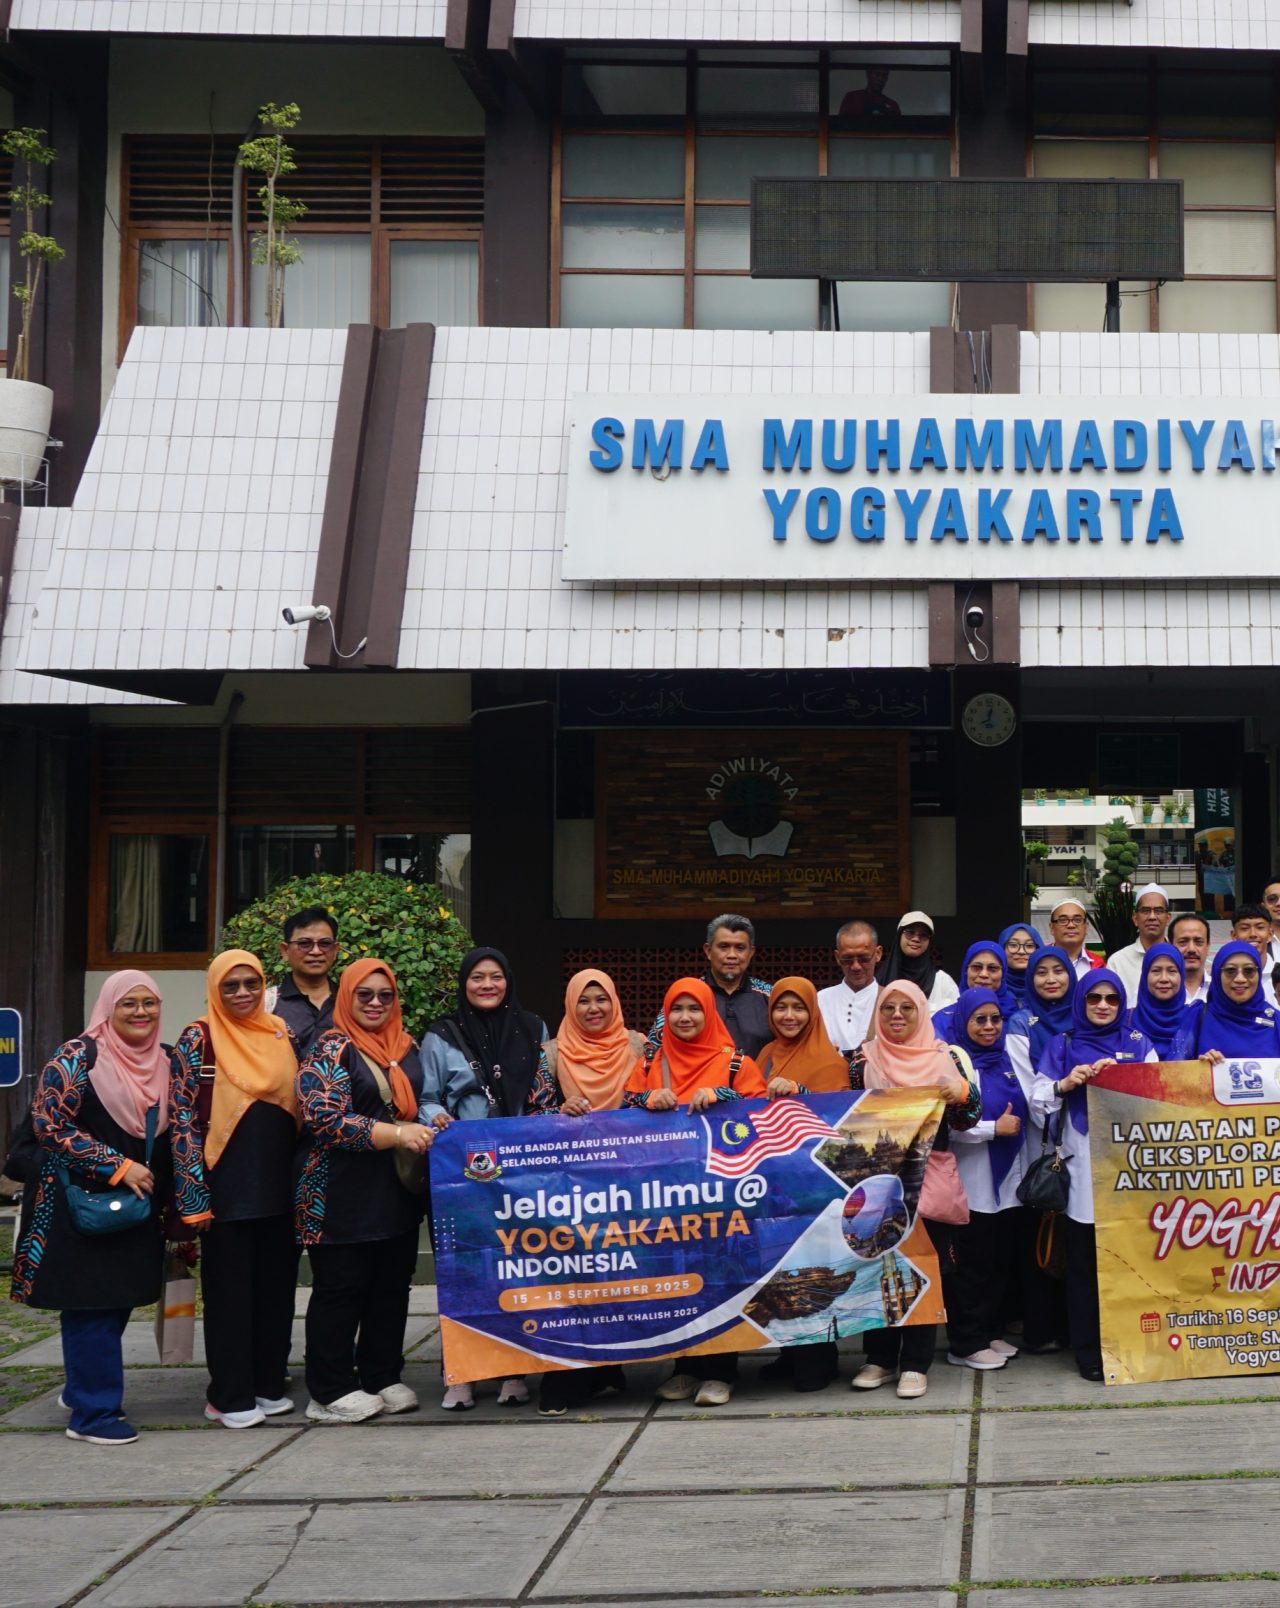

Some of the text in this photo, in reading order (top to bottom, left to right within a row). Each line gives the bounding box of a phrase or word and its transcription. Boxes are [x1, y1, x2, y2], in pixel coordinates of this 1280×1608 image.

[589, 416, 730, 474] SMA
[763, 487, 1185, 543] YOGYAKARTA
[705, 756, 799, 800] ADIWIYATA
[612, 869, 644, 885] SMA
[651, 868, 771, 885] MUHAMMADIYAH
[785, 867, 881, 884] YOGYAKARTA
[499, 1144, 523, 1155] SMK
[525, 1141, 569, 1153] BANDAR
[572, 1139, 600, 1150] BARU
[602, 1136, 643, 1147] SULTAN
[645, 1130, 700, 1144] SULEIMAN,
[1112, 1117, 1256, 1143] LAWATAN
[502, 1151, 618, 1168] SELANGOR, MALAYSIA
[1114, 1168, 1244, 1192] AKTIVITI
[494, 1173, 768, 1225] Jelajah Ilmu @
[495, 1209, 751, 1256] YOGYAKARTA
[497, 1251, 638, 1280] INDONESIA
[512, 1294, 527, 1304] 15
[547, 1291, 562, 1301] 18
[568, 1284, 649, 1299] SEPTEMBER
[655, 1280, 690, 1293] 2025
[542, 1307, 698, 1329] ANJURAN KELAB KHALISH 2025
[1166, 1310, 1224, 1328] Tarikh:
[1226, 1308, 1243, 1325] 16
[1187, 1333, 1258, 1354] Tempat:
